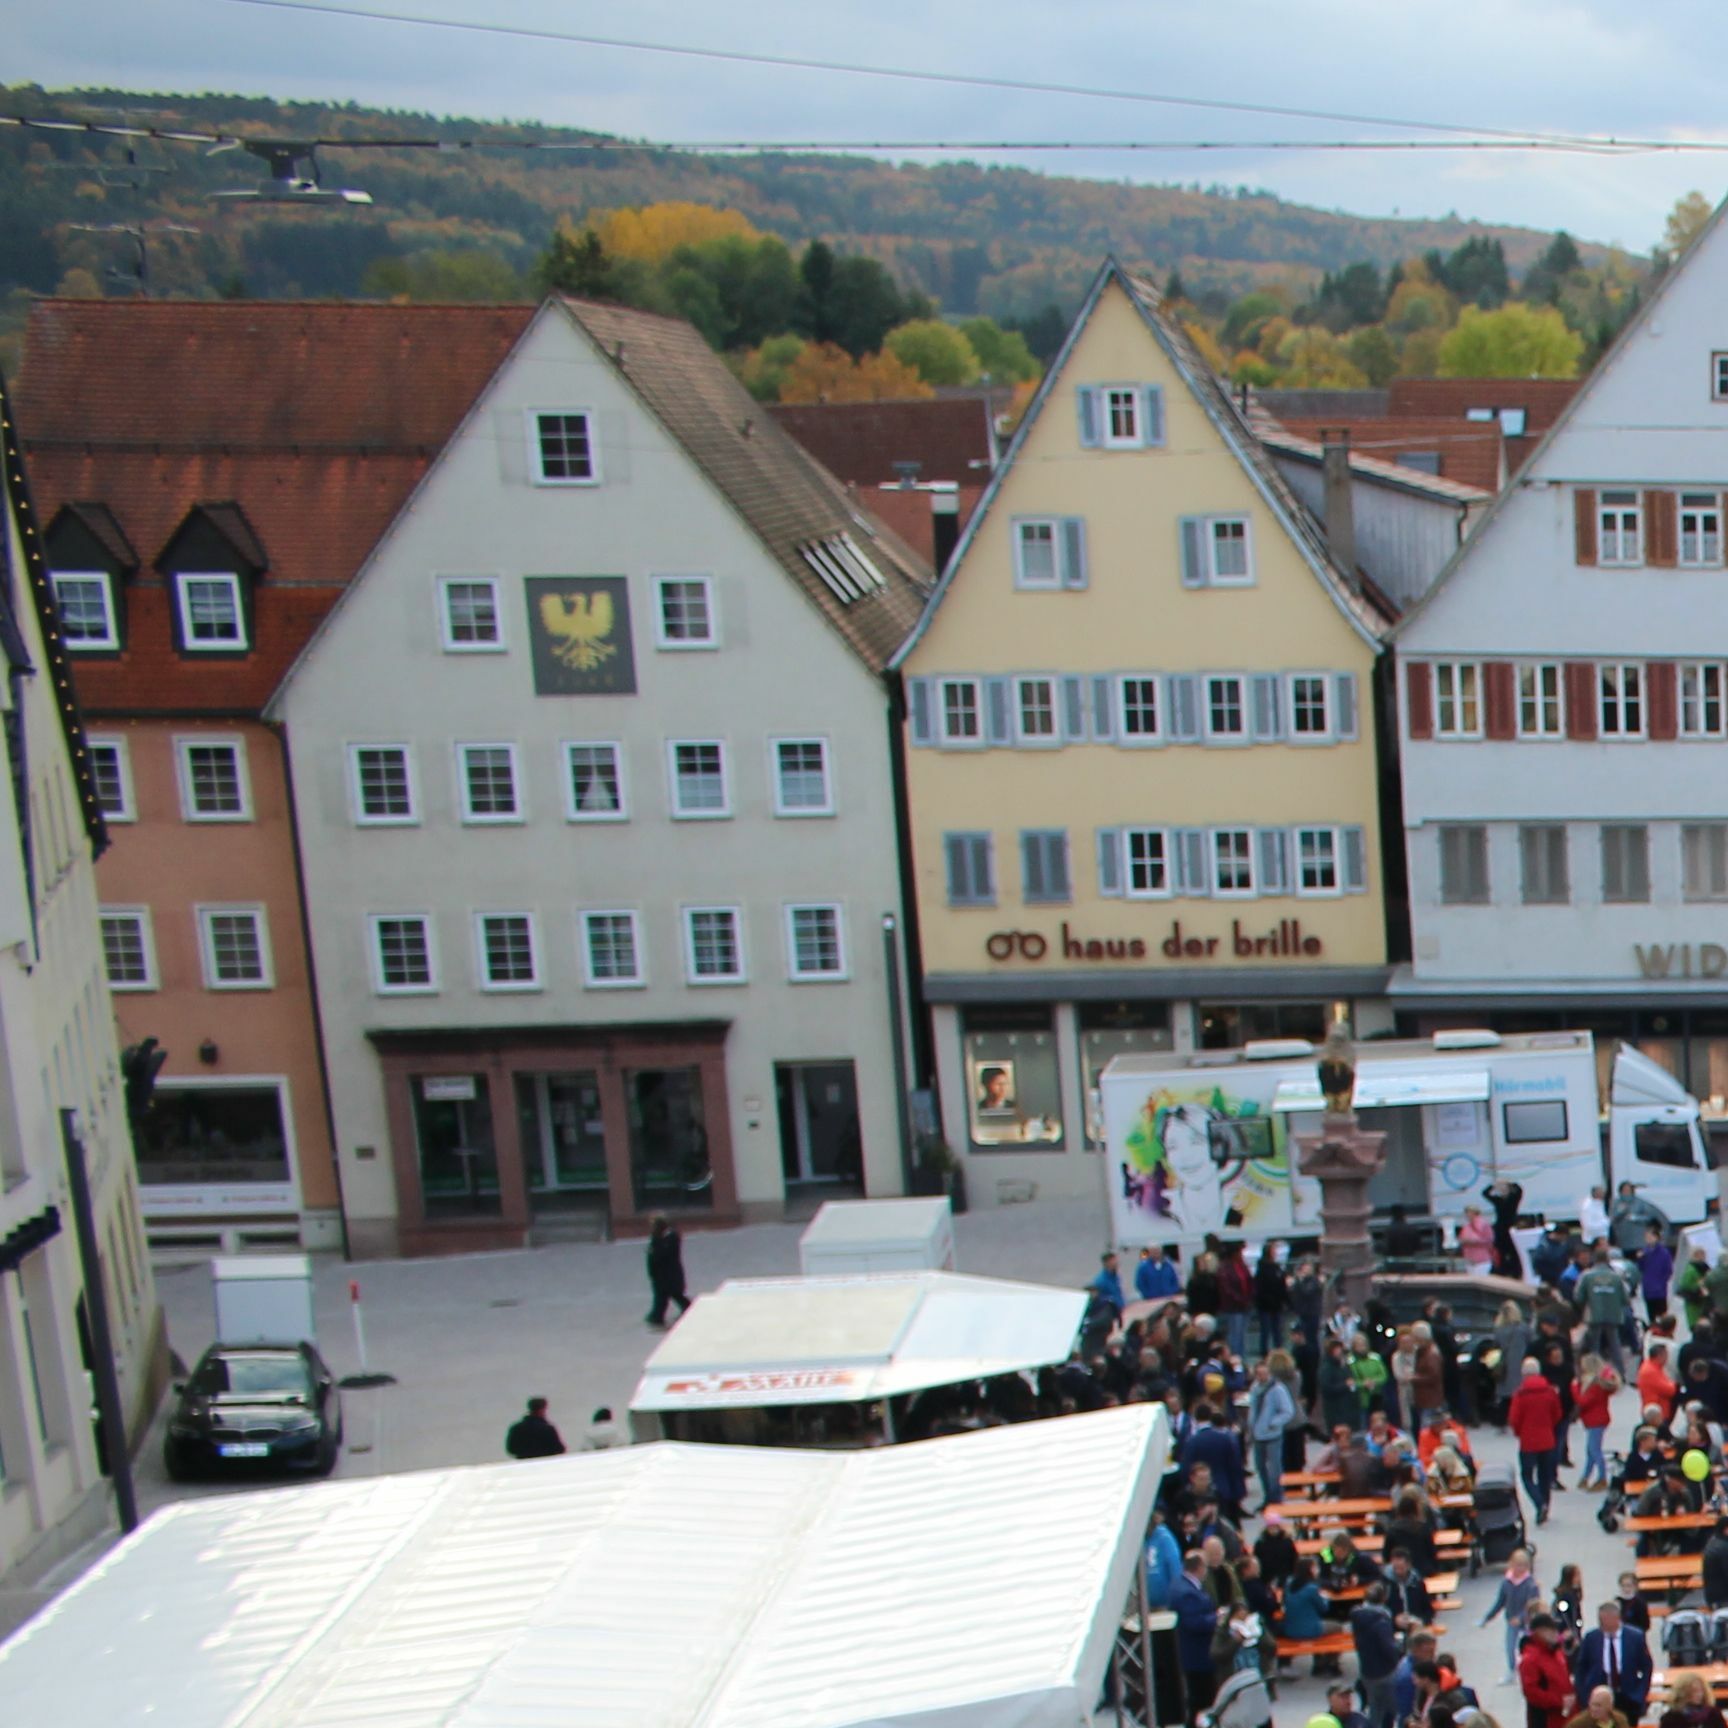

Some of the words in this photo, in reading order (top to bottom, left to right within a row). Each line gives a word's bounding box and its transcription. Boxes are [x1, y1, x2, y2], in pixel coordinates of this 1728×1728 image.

[1062, 922, 1145, 961] haus
[1162, 921, 1219, 958] der
[1233, 919, 1321, 957] brille
